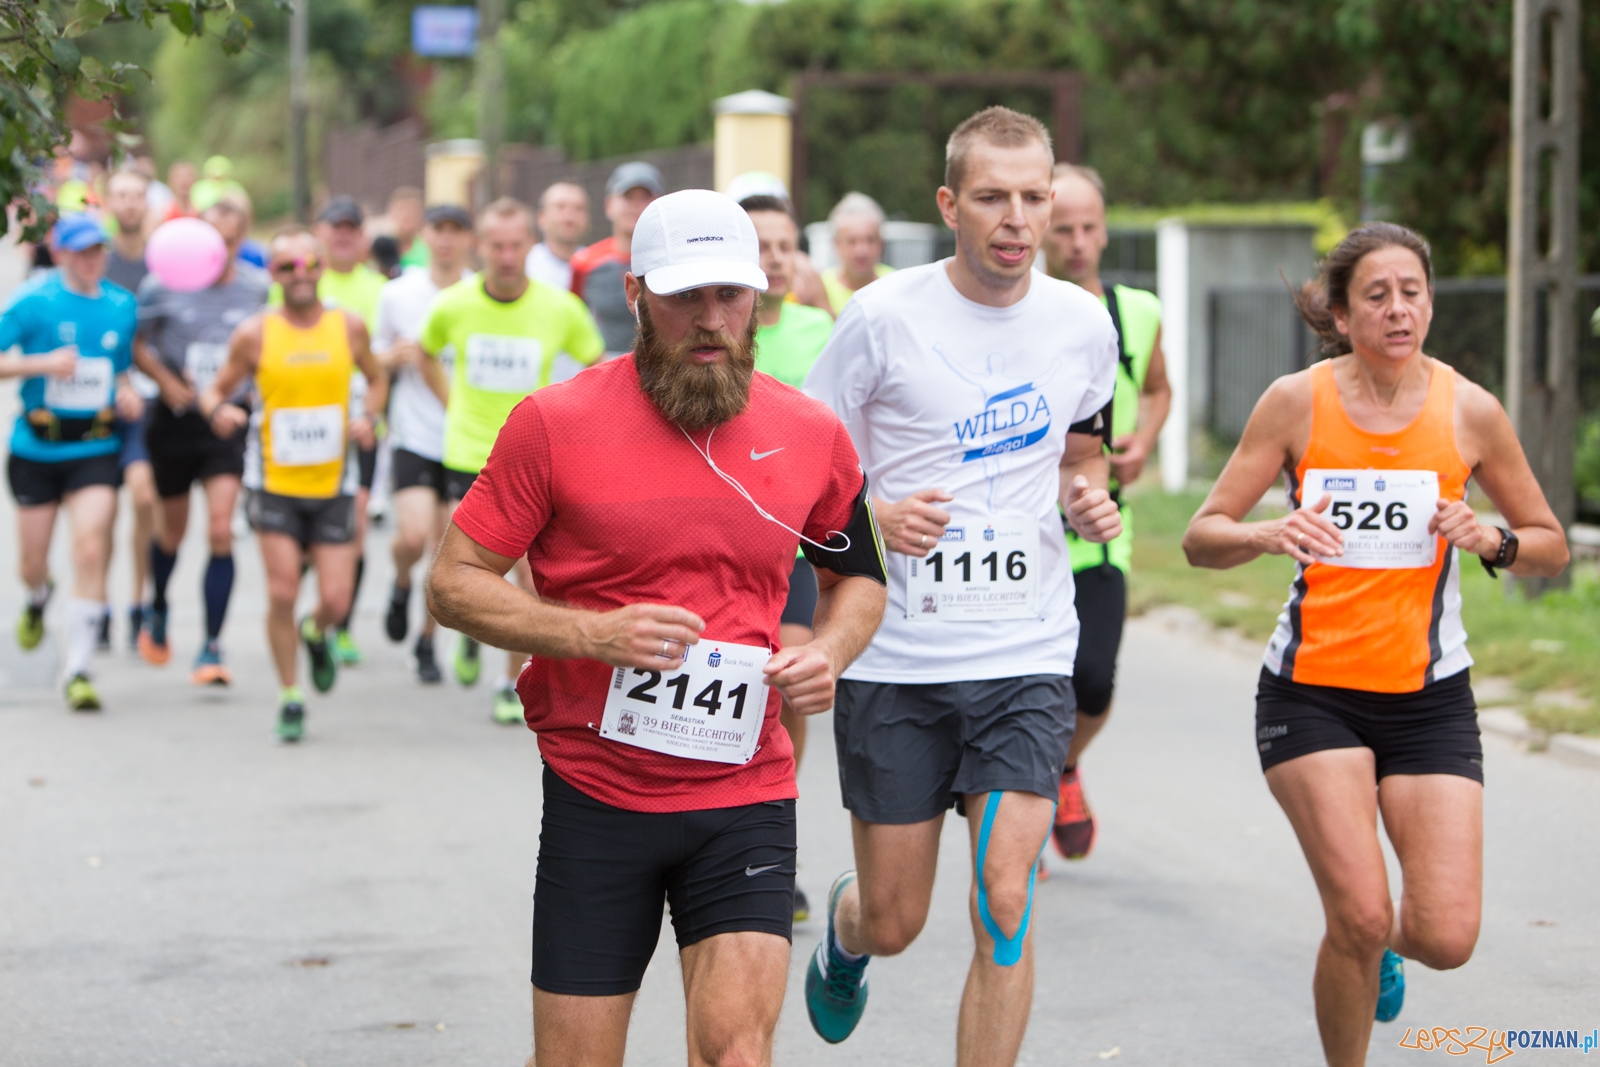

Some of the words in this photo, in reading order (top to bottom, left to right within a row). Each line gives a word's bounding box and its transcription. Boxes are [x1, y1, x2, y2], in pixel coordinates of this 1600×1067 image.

[953, 394, 1051, 445] WILDA
[1331, 501, 1408, 531] 526
[925, 550, 1027, 582] 1116
[957, 593, 978, 602] BIEG
[626, 667, 748, 719] 2141
[643, 716, 658, 728] 39
[661, 720, 689, 735] BIEG
[692, 727, 746, 742] LECHITÓW
[670, 714, 706, 725] SEBASTIAN
